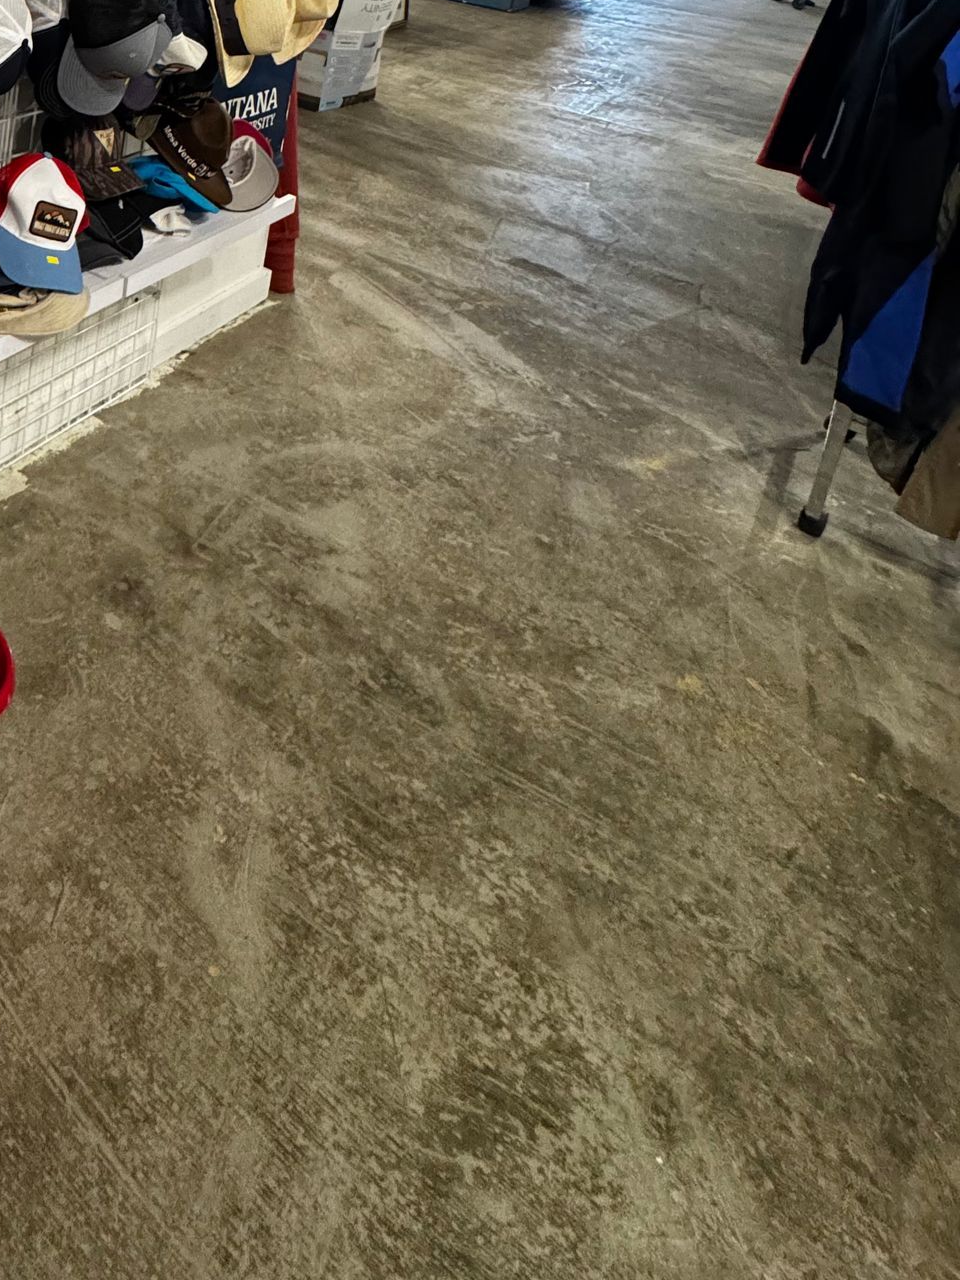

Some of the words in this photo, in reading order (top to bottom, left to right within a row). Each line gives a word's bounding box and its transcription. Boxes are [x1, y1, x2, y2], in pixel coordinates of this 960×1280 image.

[221, 86, 278, 120] NTANA
[163, 124, 179, 148] Mesa
[177, 145, 198, 169] Verde
